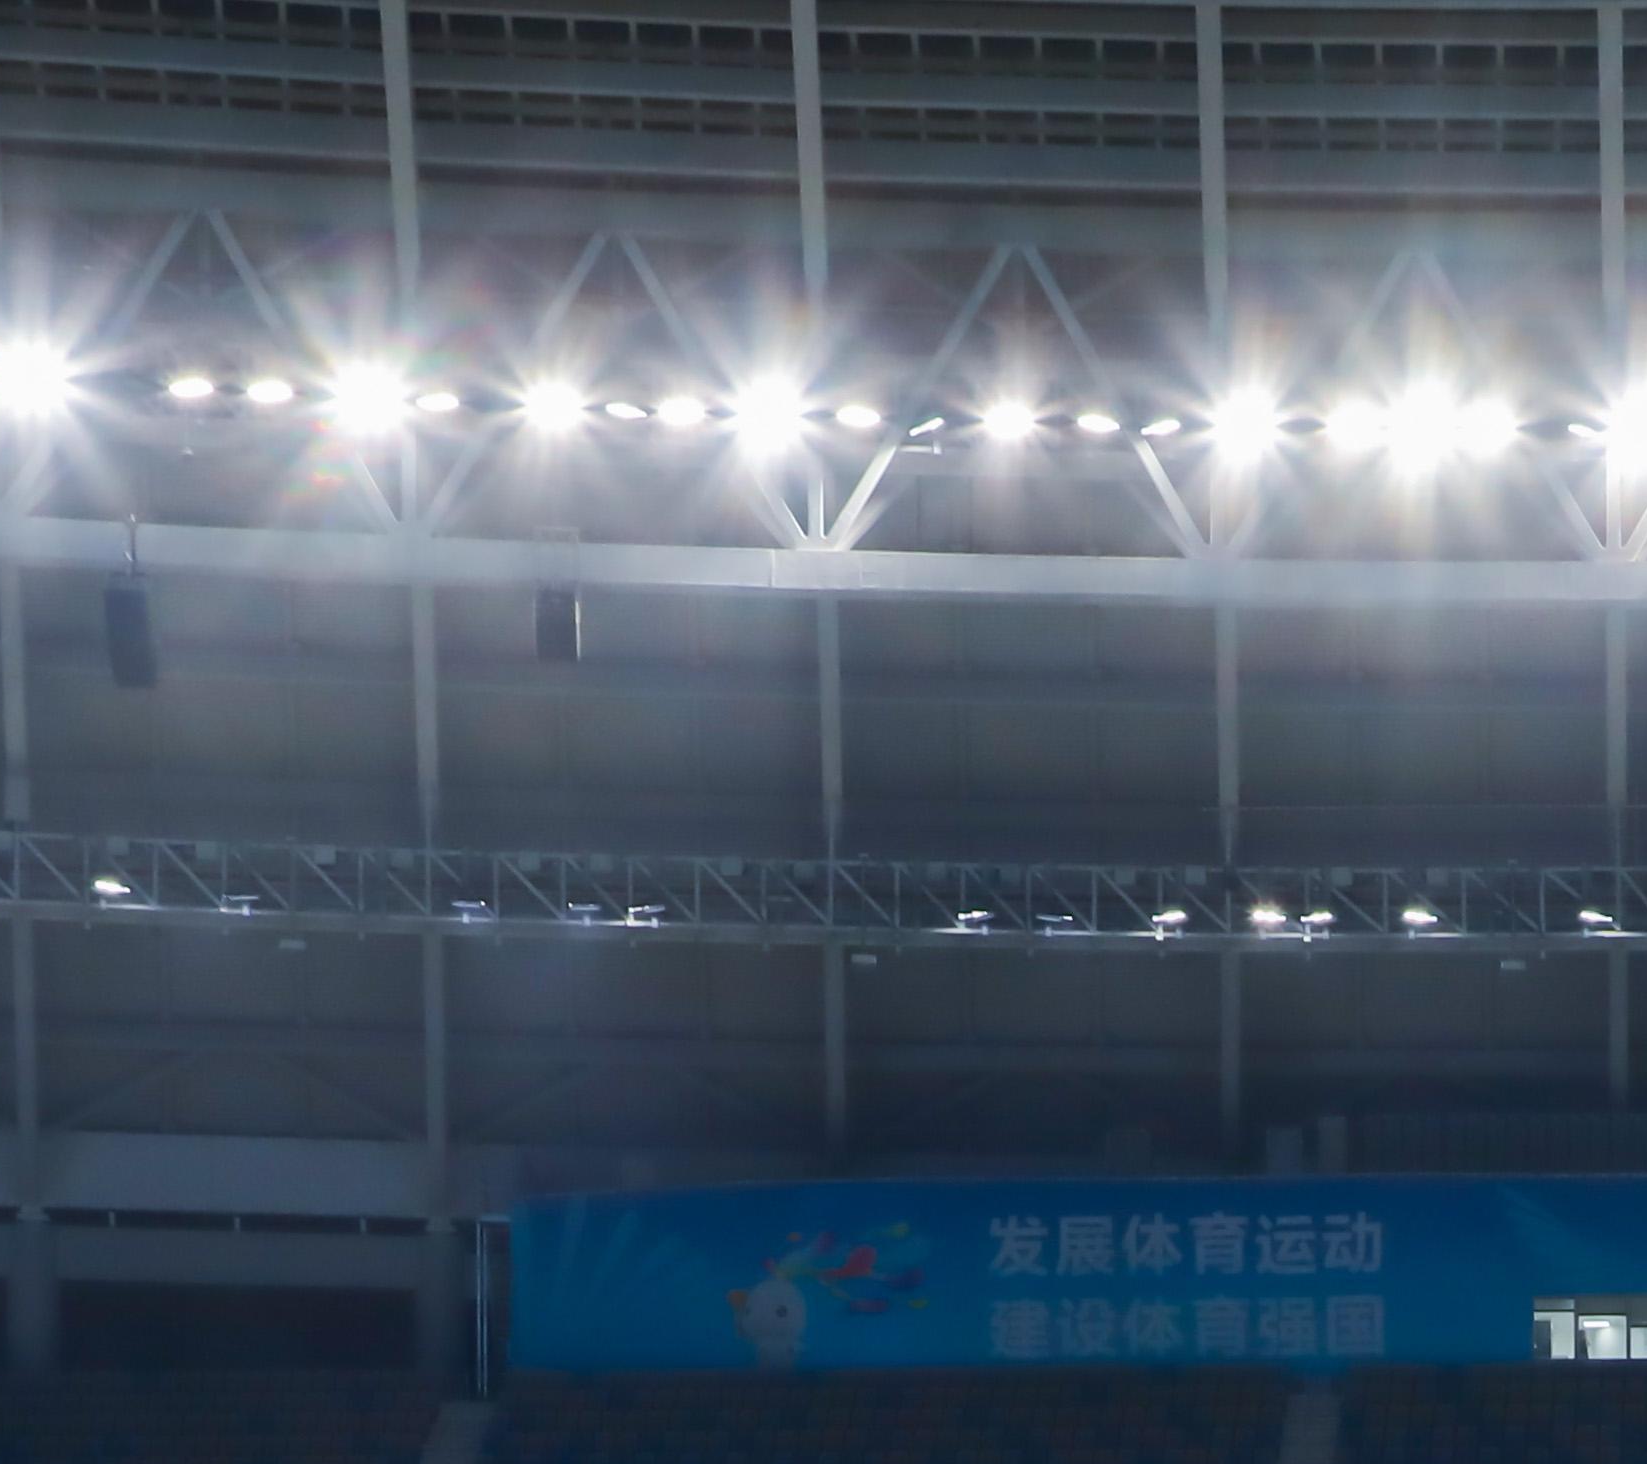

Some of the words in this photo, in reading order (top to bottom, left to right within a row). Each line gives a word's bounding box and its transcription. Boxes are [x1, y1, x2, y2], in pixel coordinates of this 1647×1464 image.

[988, 1212, 1385, 1276] 发展体育运动
[990, 1295, 1386, 1358] 建设体育强国
